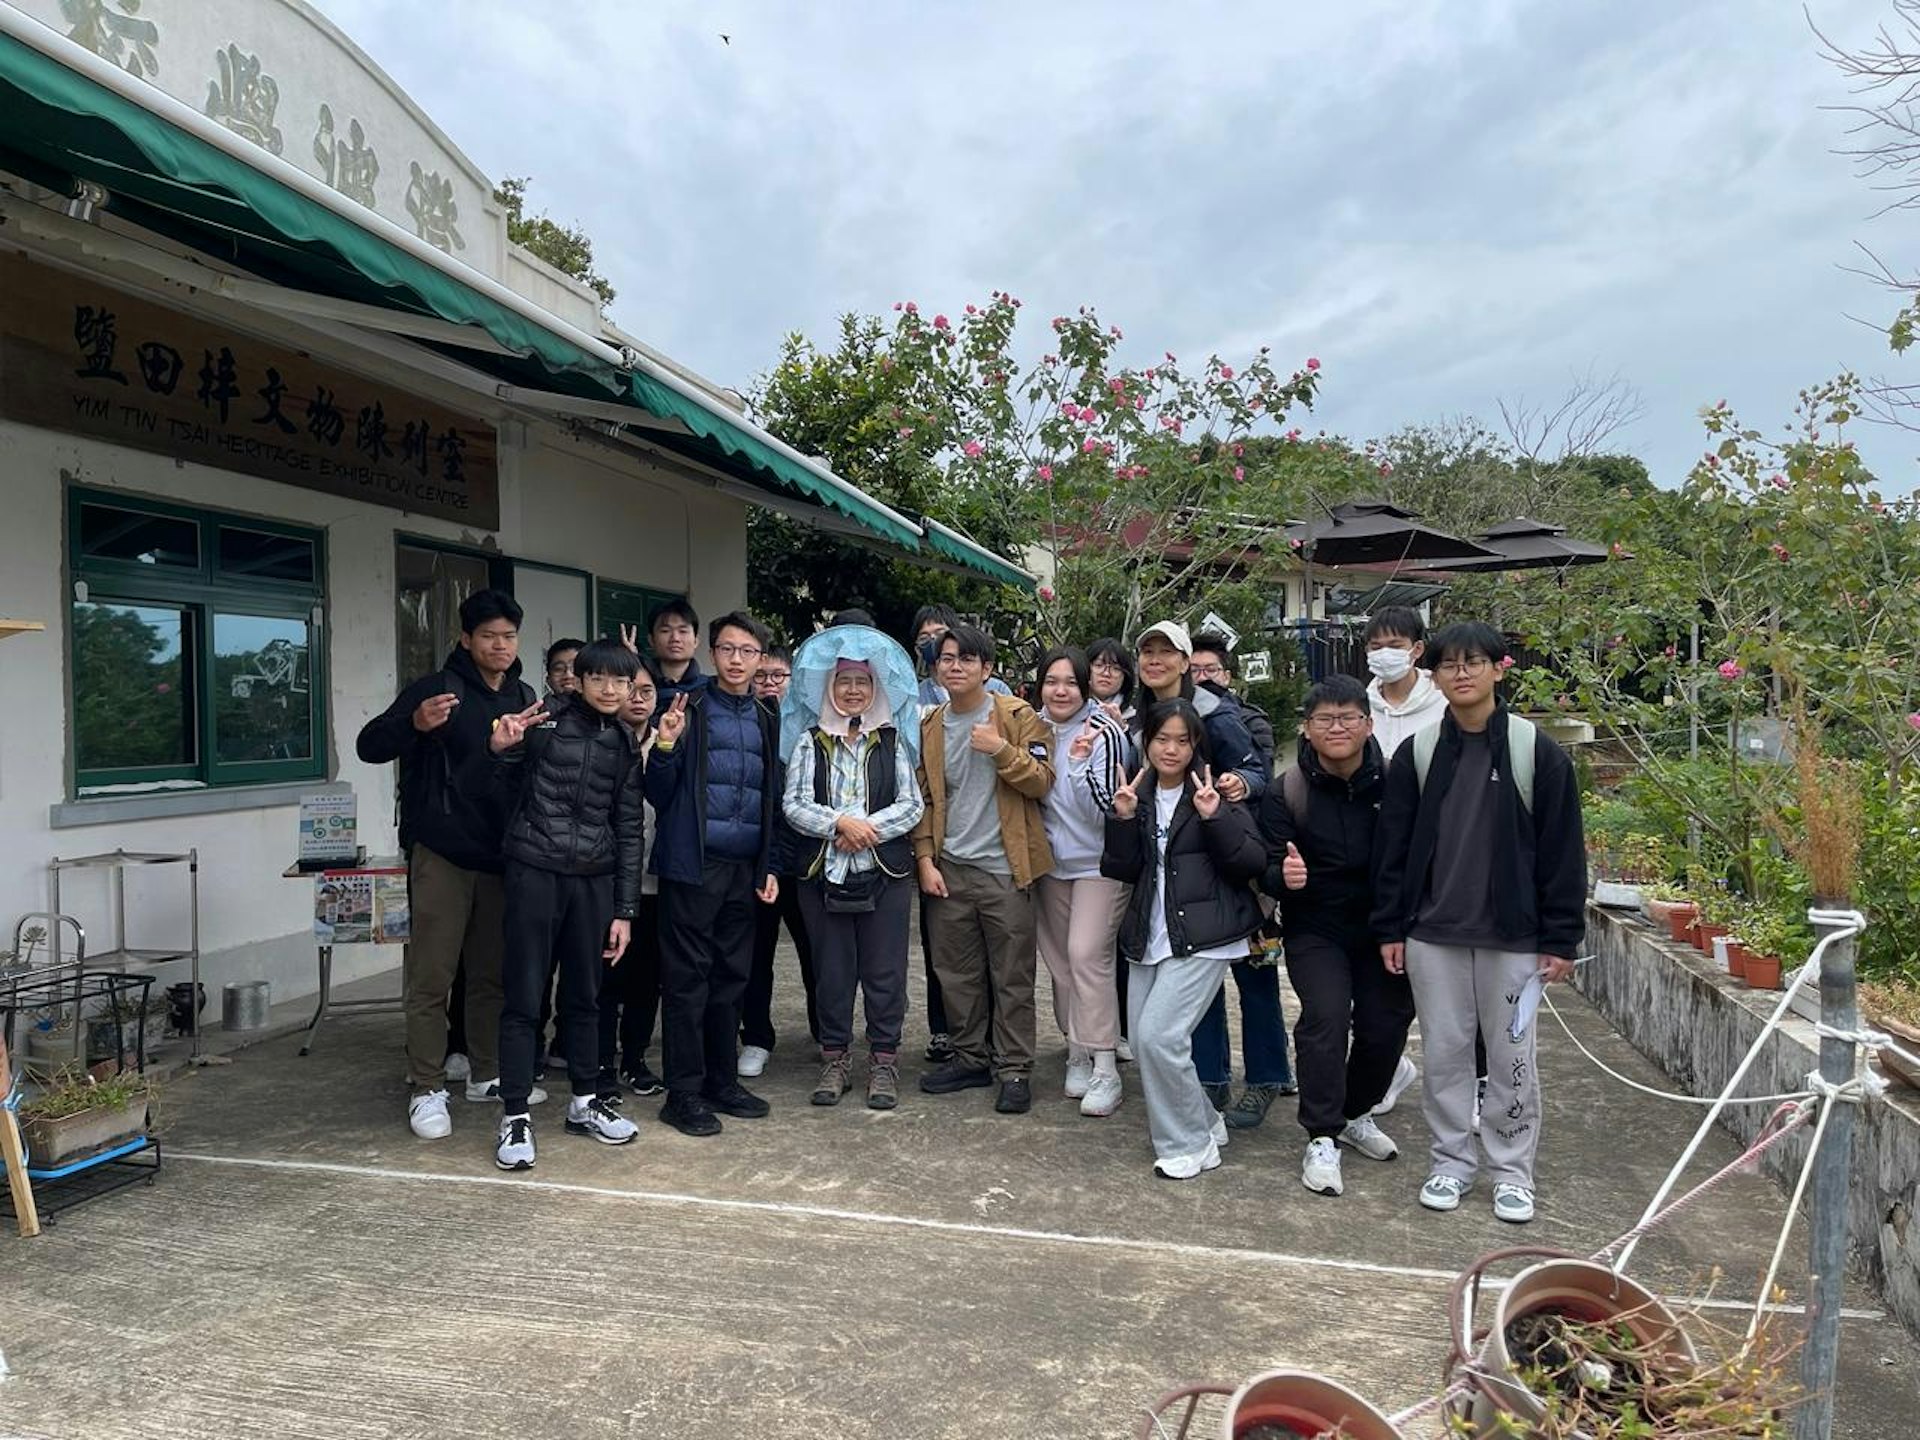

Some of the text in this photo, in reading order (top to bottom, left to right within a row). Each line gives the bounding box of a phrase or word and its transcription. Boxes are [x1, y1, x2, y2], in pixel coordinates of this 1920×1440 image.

[73, 394, 469, 510] YIM TIN TSAI HERITAGE EXHIBITION CENTRE
